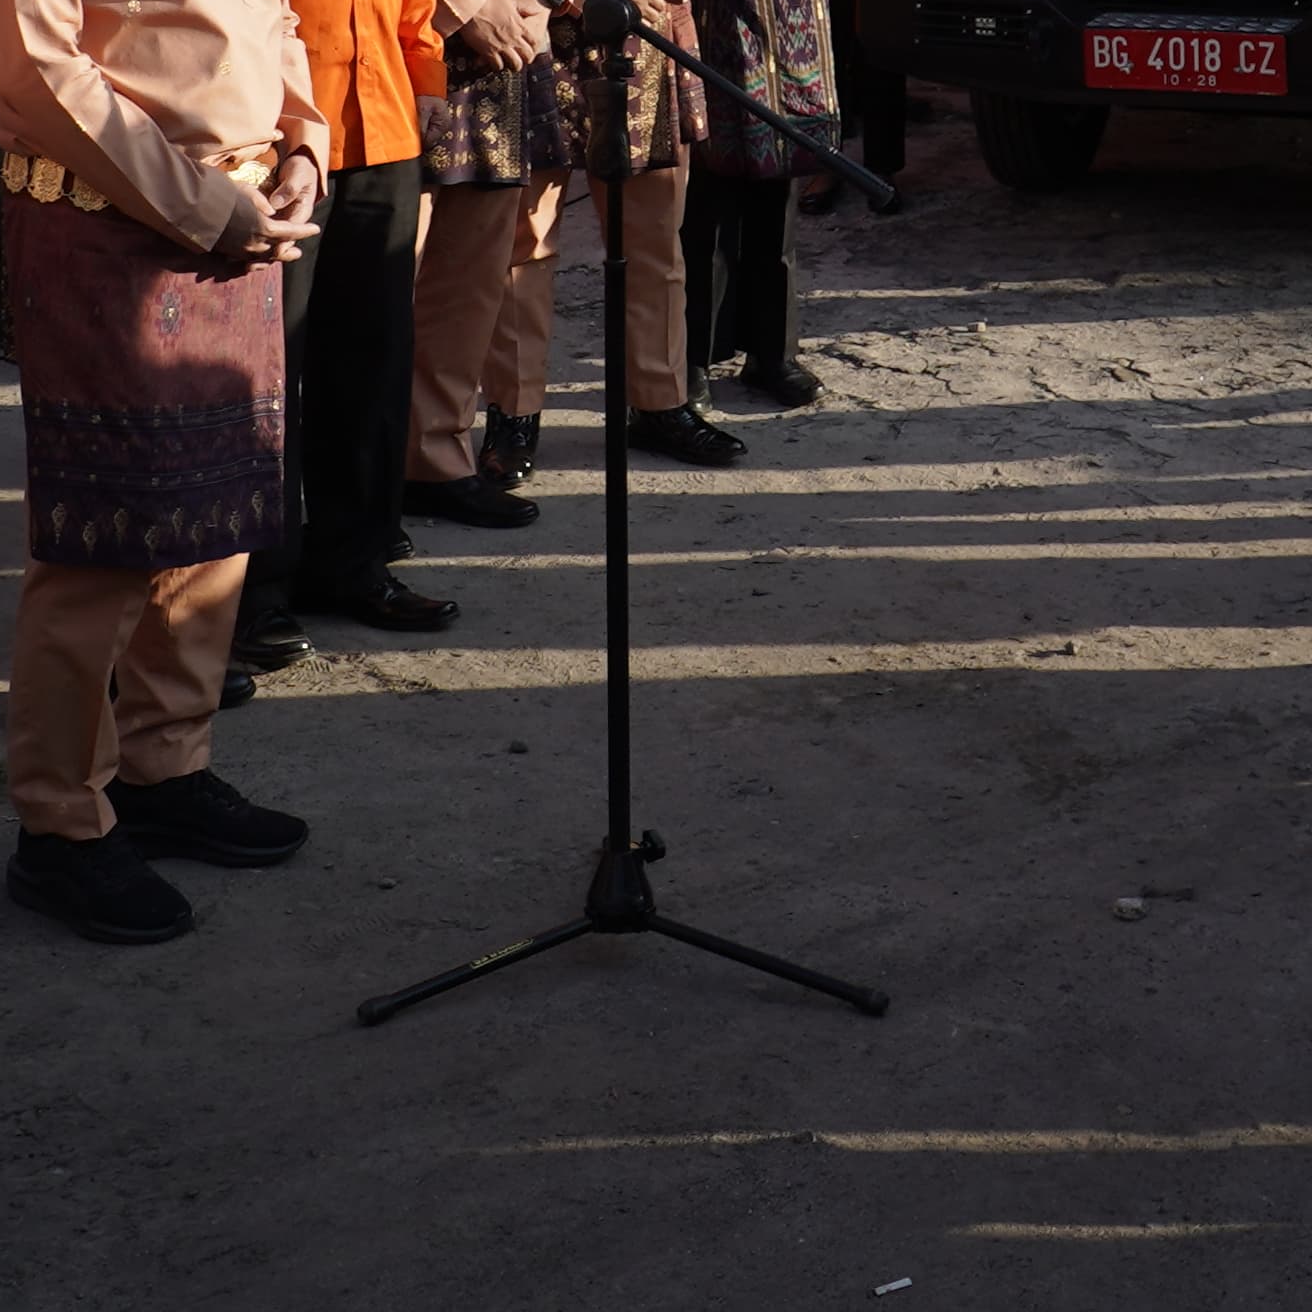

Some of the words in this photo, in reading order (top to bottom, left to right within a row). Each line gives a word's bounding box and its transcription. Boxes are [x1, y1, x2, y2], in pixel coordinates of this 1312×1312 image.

[1093, 36, 1129, 70] BG
[1147, 36, 1221, 72] 4018
[1239, 40, 1276, 75] CZ
